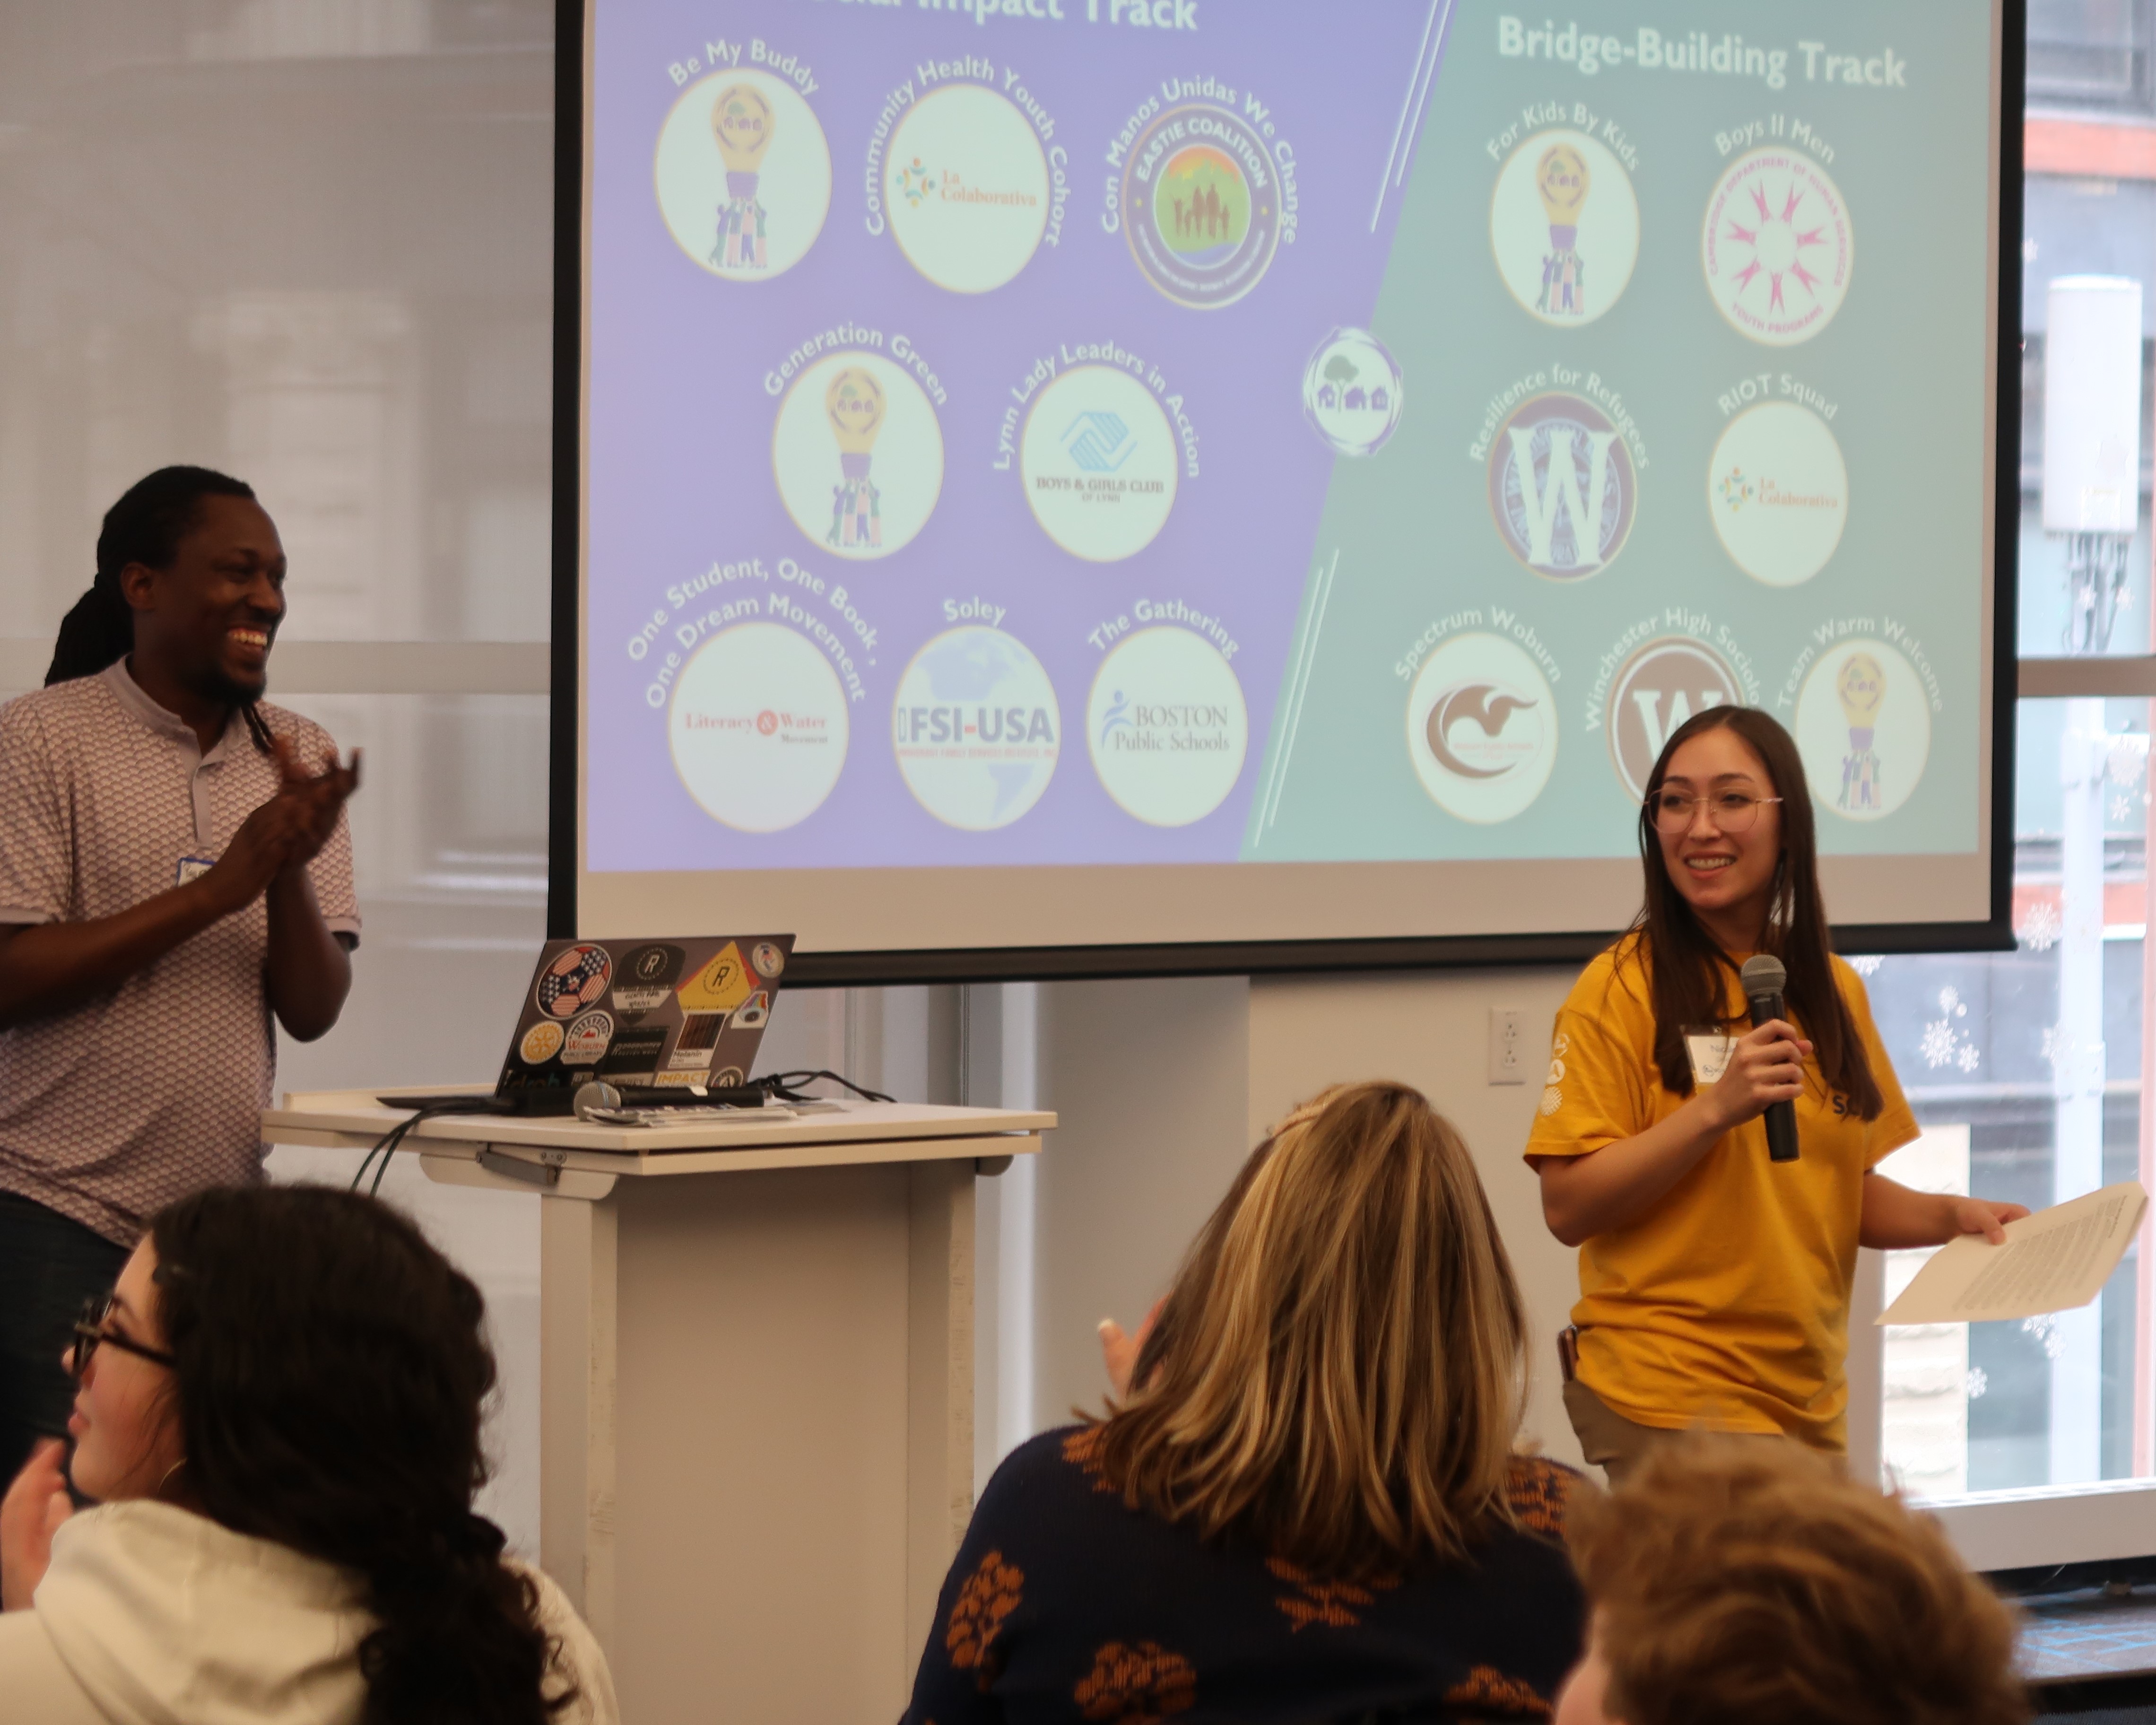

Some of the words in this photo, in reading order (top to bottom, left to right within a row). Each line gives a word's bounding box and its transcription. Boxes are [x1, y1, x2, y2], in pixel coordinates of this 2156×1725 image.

[668, 57, 702, 87] Be
[705, 39, 742, 68] My
[750, 39, 819, 96] Buddy
[1499, 16, 1787, 88] Bridge-Building
[1798, 41, 1906, 87] Track
[1162, 75, 1237, 105] Unidas
[1244, 92, 1276, 138] We
[866, 79, 916, 236] Community
[917, 55, 995, 87] Health
[1004, 67, 1055, 140] Youth
[1044, 146, 1072, 248] Cohort
[1106, 96, 1160, 168] Manos
[1137, 120, 1186, 183] EASTIE
[1187, 117, 1268, 188] COALITION
[1486, 122, 1519, 162] For
[1522, 101, 1567, 130] Kids
[1573, 102, 1600, 133] By
[1602, 119, 1640, 172] Kids
[1714, 117, 1765, 157] Boys
[1791, 118, 1836, 165] Men
[940, 187, 1037, 208] Colaborativa
[942, 169, 961, 185] La
[1102, 175, 1120, 234] Con
[1274, 140, 1299, 245] Change
[763, 322, 885, 396] Generation
[890, 333, 948, 405] Green
[992, 401, 1021, 471] Lynn
[1011, 355, 1058, 404] Lady
[1060, 339, 1146, 375] Leaders
[1148, 366, 1168, 393] in
[1165, 393, 1200, 478] Action
[1469, 369, 1547, 463] Resilience
[1552, 363, 1582, 386] for
[1586, 372, 1650, 470] Refugees
[1717, 374, 1773, 416] RIOT
[1780, 373, 1839, 420] Squad
[1036, 477, 1071, 490] BOYS
[1088, 478, 1127, 491] GIRLS
[1130, 480, 1164, 493] CLUB
[1507, 427, 1621, 566] W
[628, 609, 669, 661] One
[667, 558, 769, 610] Student,
[778, 557, 826, 595] One
[943, 595, 1007, 628] Soley
[1087, 614, 1131, 652] The
[1134, 598, 1240, 661] Gathering
[645, 651, 682, 708] One
[675, 597, 760, 650] Dream
[768, 592, 866, 702] Movement
[1395, 609, 1483, 681] Spectrum
[1491, 604, 1561, 684] Woburn
[1585, 615, 1659, 732] Winchester
[1665, 605, 1712, 636] High
[1715, 625, 1760, 706] Sociolo
[1777, 645, 1815, 709] Team
[1812, 616, 1876, 646] Warm
[1884, 615, 1944, 711] Welcome
[685, 712, 754, 734] Literacy
[780, 713, 827, 729] Water
[1115, 731, 1166, 751] Public
[1169, 731, 1230, 752] Schools
[1136, 705, 1228, 727] BOSTON
[644, 954, 660, 973] R
[712, 966, 730, 987] R
[657, 1070, 709, 1083] IMPACT
